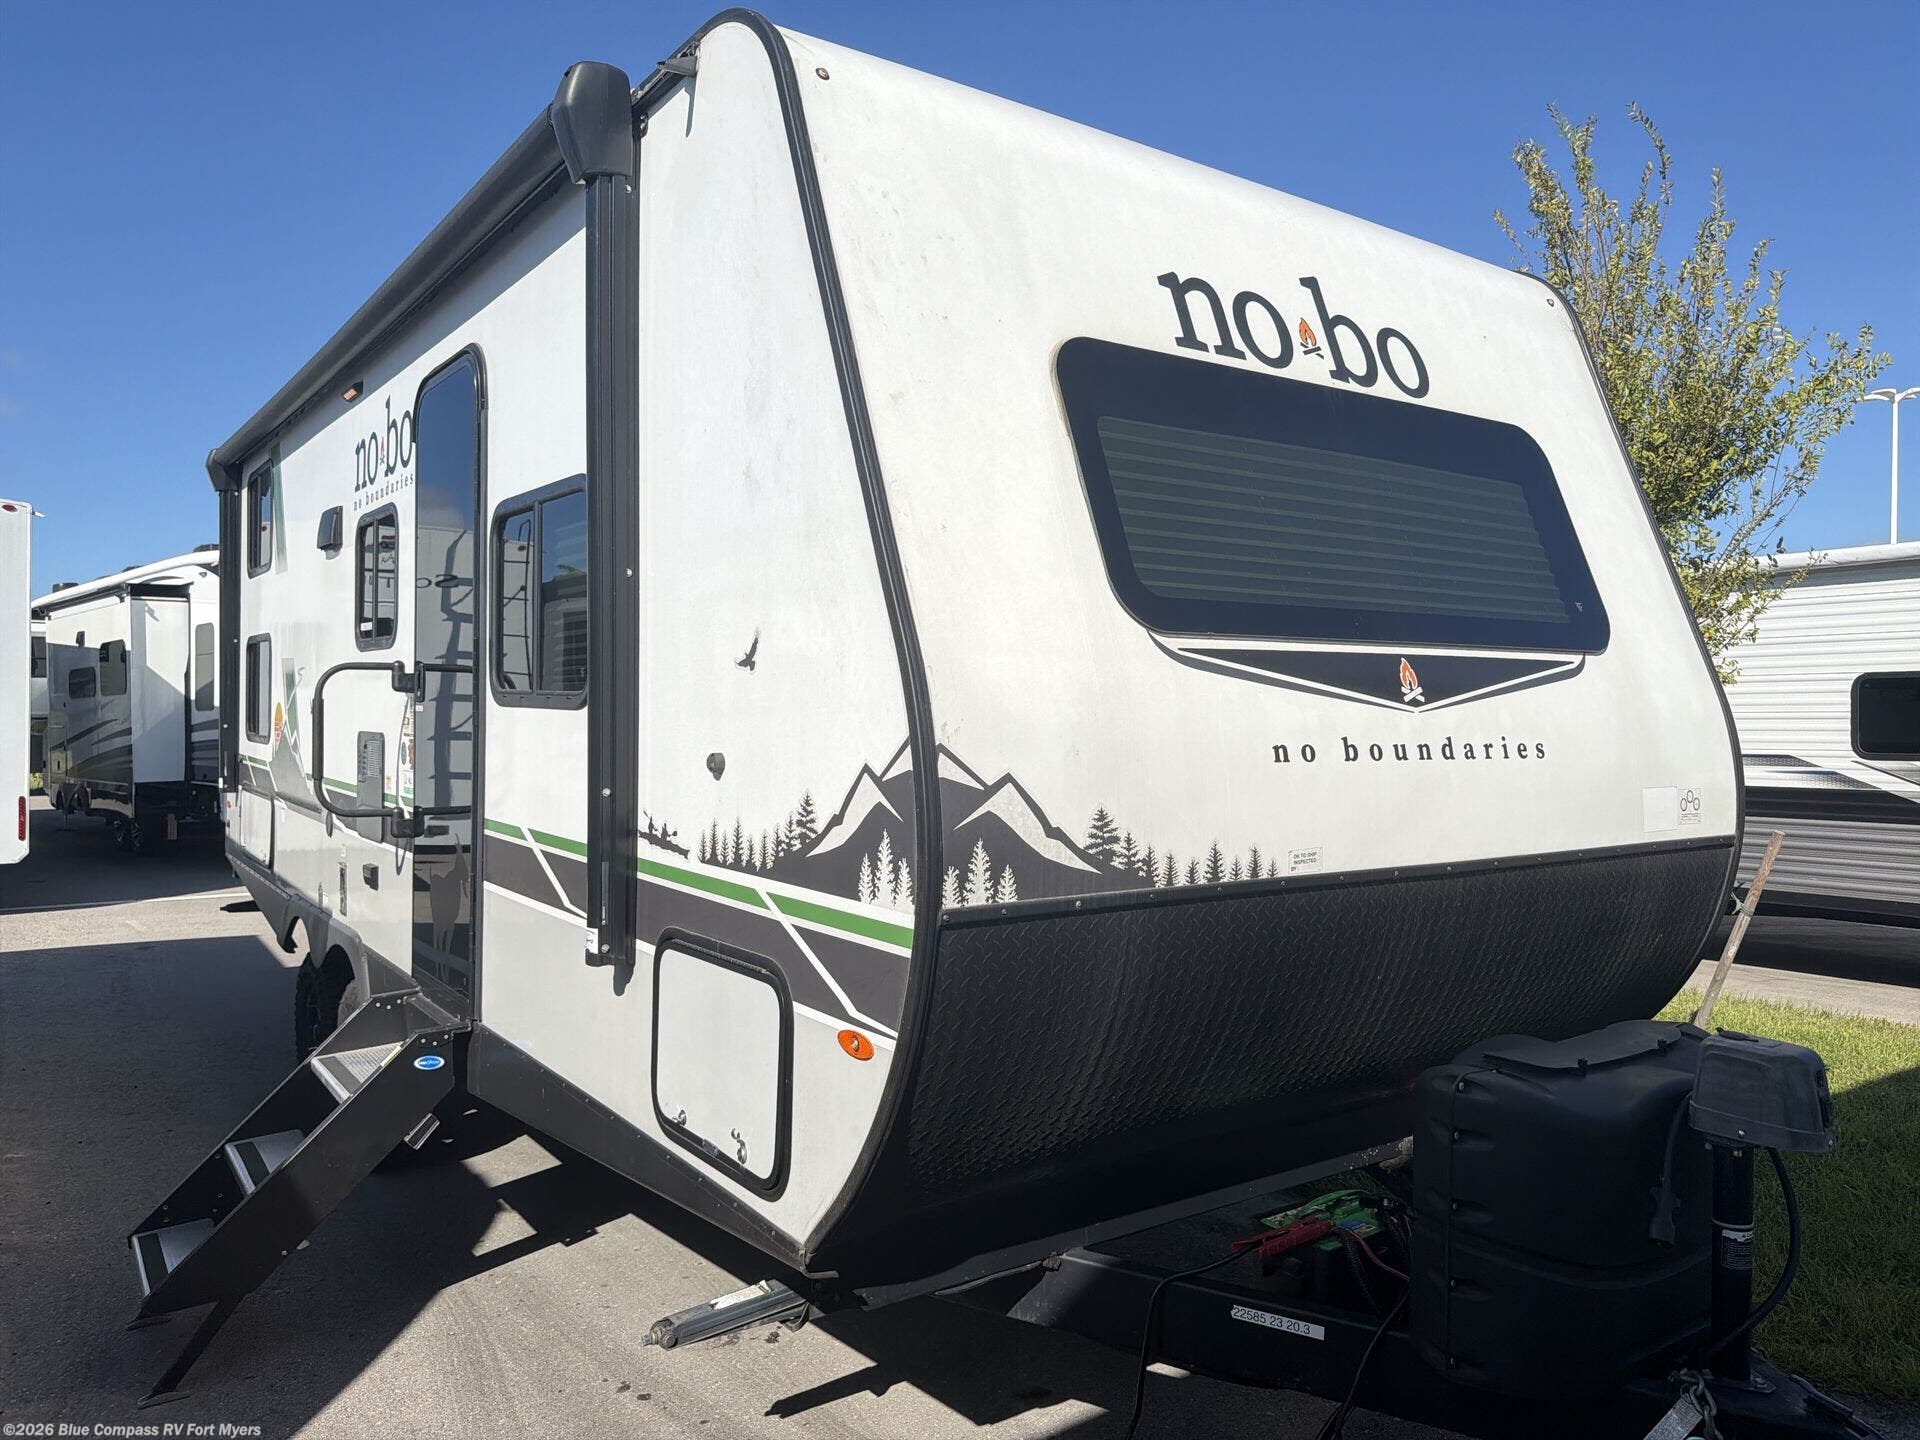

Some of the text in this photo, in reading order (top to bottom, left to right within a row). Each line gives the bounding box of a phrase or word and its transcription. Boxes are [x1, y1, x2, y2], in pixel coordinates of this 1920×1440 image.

[353, 473, 414, 511] no boundaries
[1272, 736, 1546, 763] no boundaries
[1233, 1306, 1311, 1335] 22585 23 20.3
